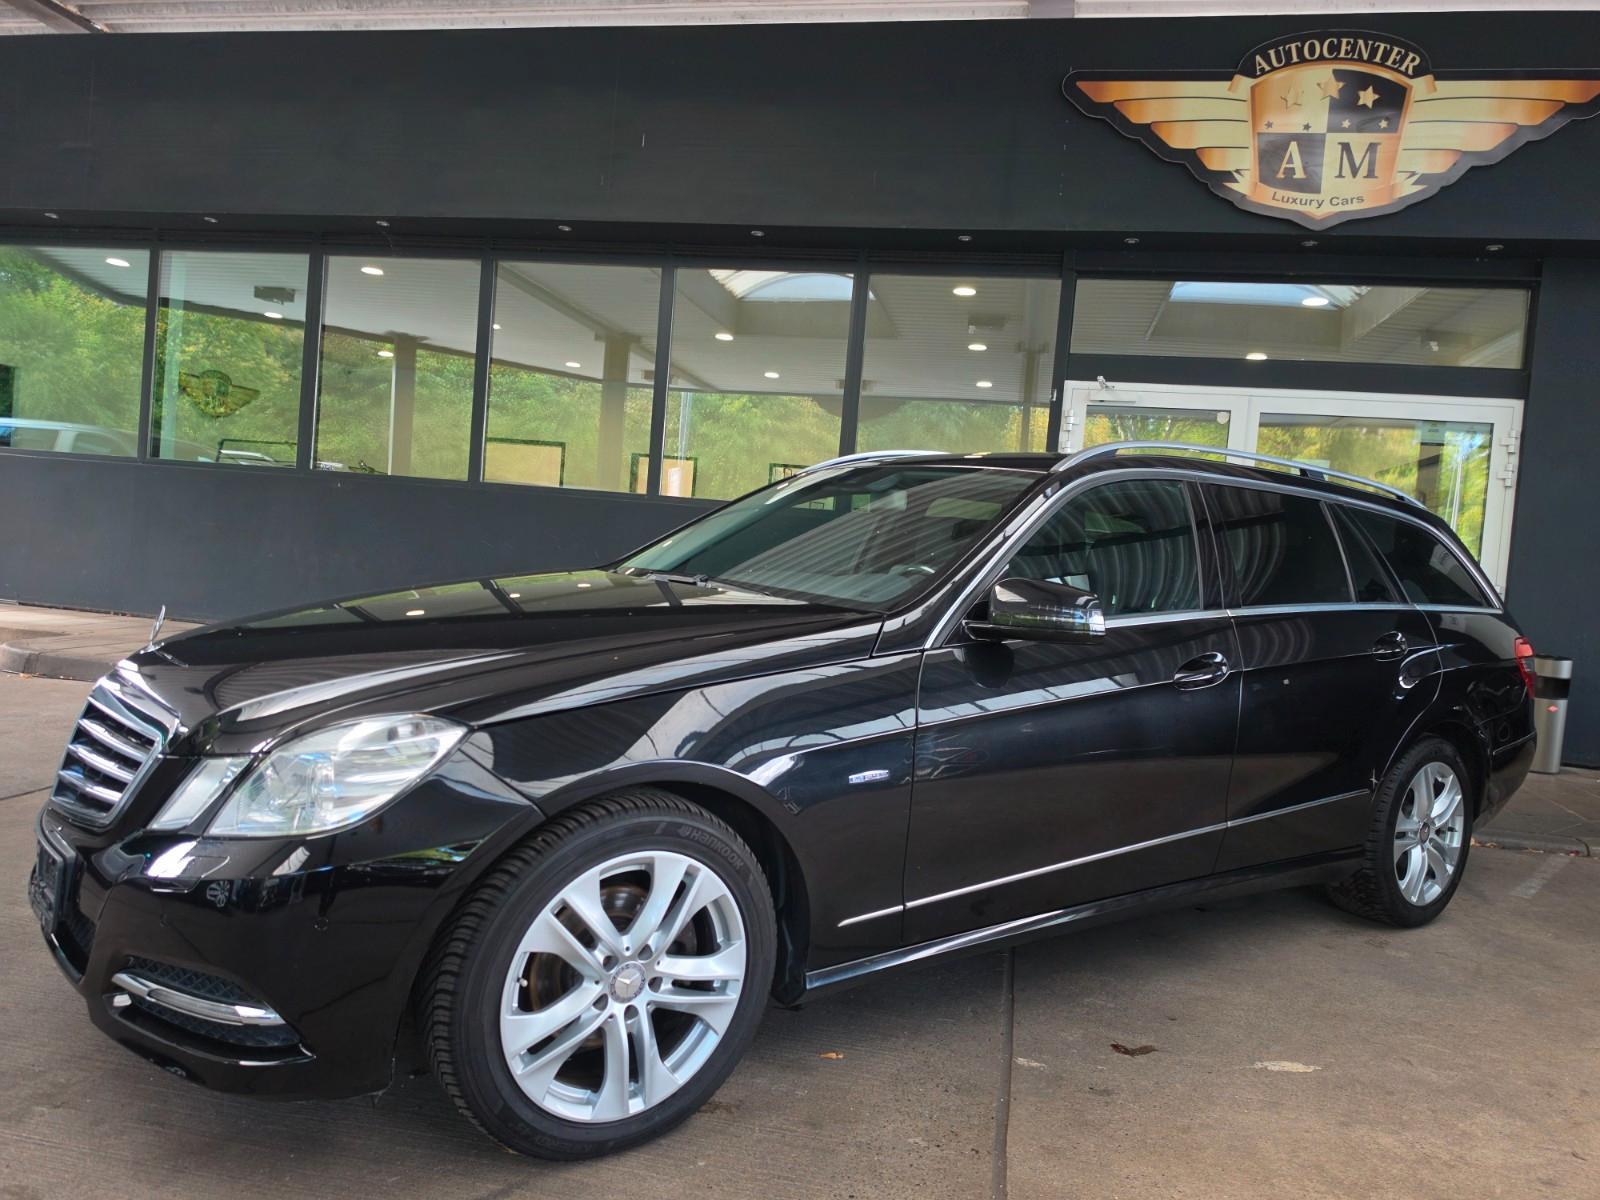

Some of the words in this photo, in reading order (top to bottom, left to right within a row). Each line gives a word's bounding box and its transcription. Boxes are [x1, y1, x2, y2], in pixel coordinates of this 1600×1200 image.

[1255, 38, 1421, 76] AUTOCENTER
[1276, 141, 1307, 179] A
[1334, 142, 1382, 179] M
[1271, 191, 1325, 209] Luxury
[1329, 195, 1365, 207] Cars
